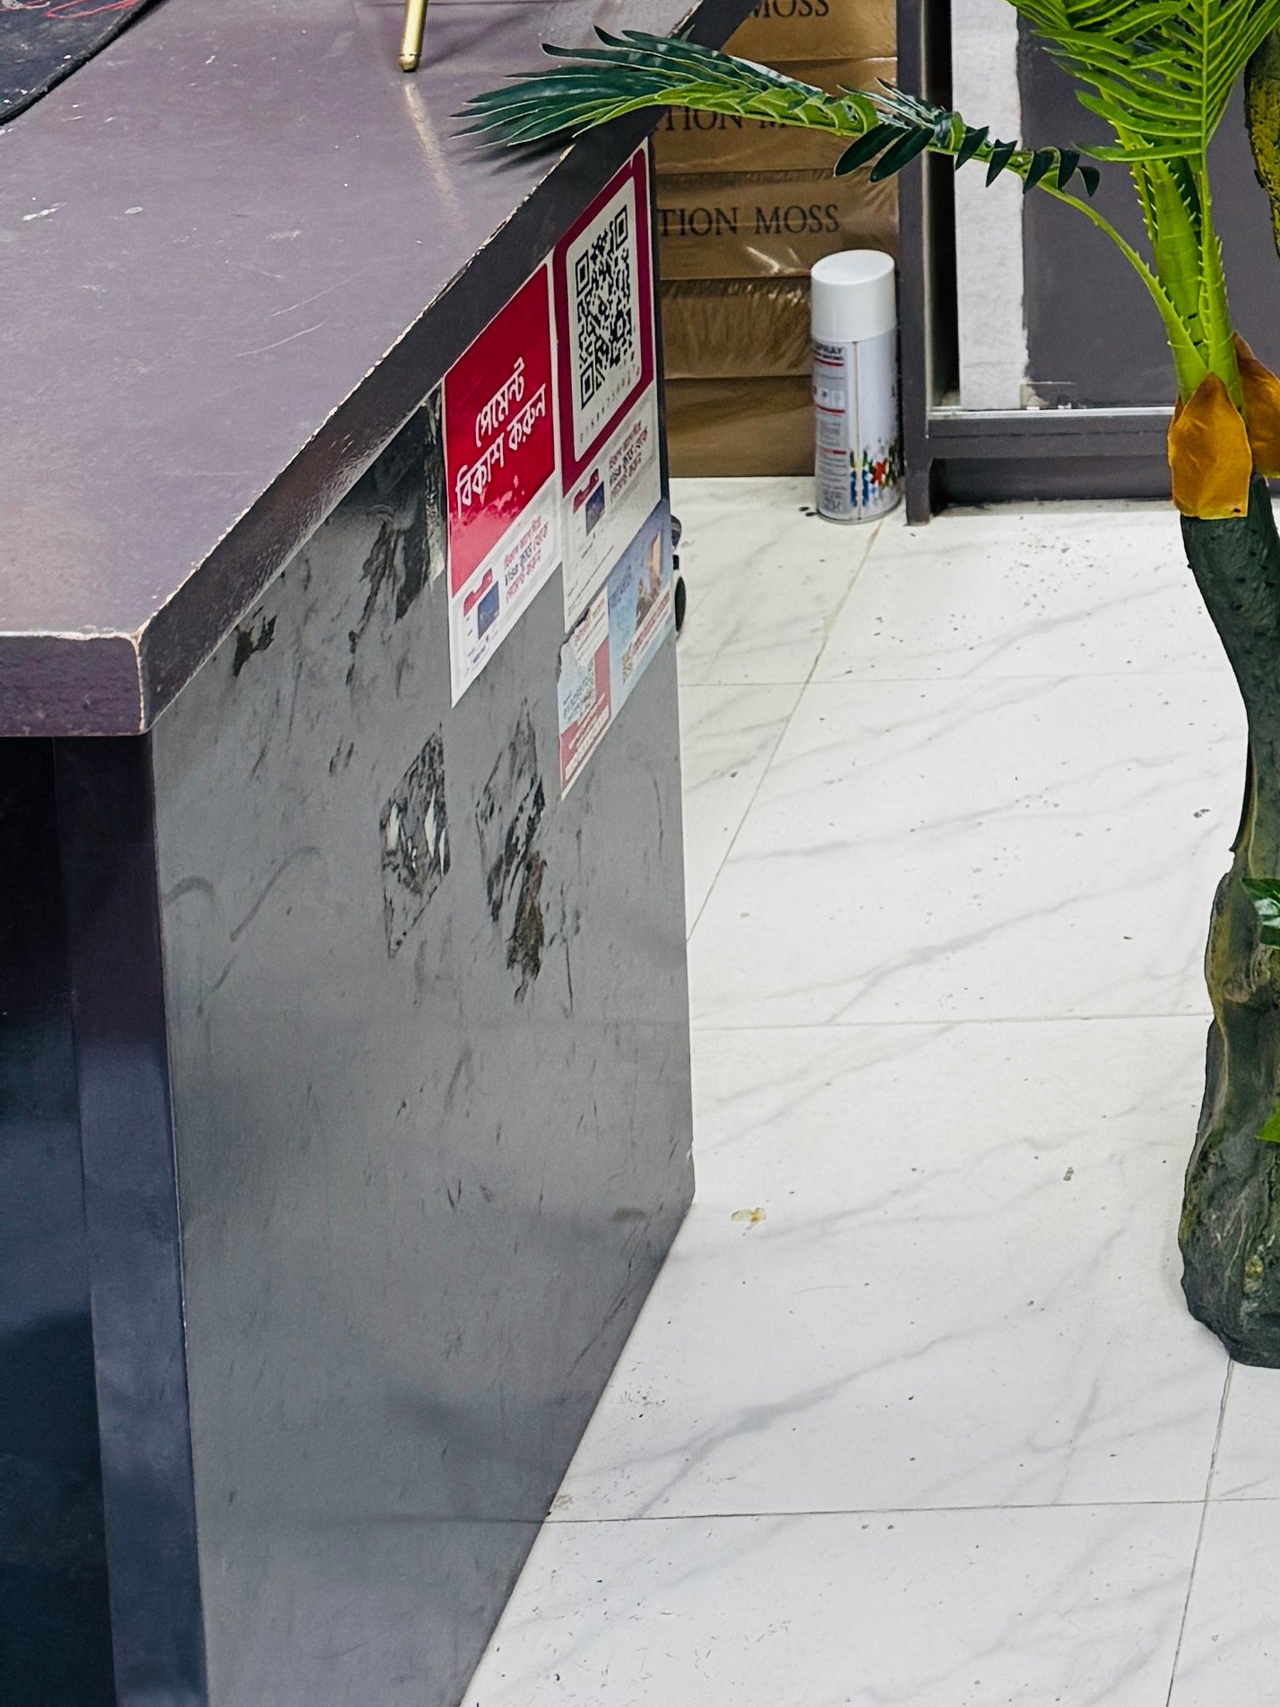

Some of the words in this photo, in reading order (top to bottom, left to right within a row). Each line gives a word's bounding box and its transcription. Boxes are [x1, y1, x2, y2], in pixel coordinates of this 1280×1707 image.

[656, 105, 744, 132] TION
[654, 206, 738, 238] TION
[754, 203, 841, 235] MOSS
[475, 356, 525, 448] পেমেন্ট
[455, 432, 505, 519] বিকাশ
[507, 383, 546, 451] করুন
